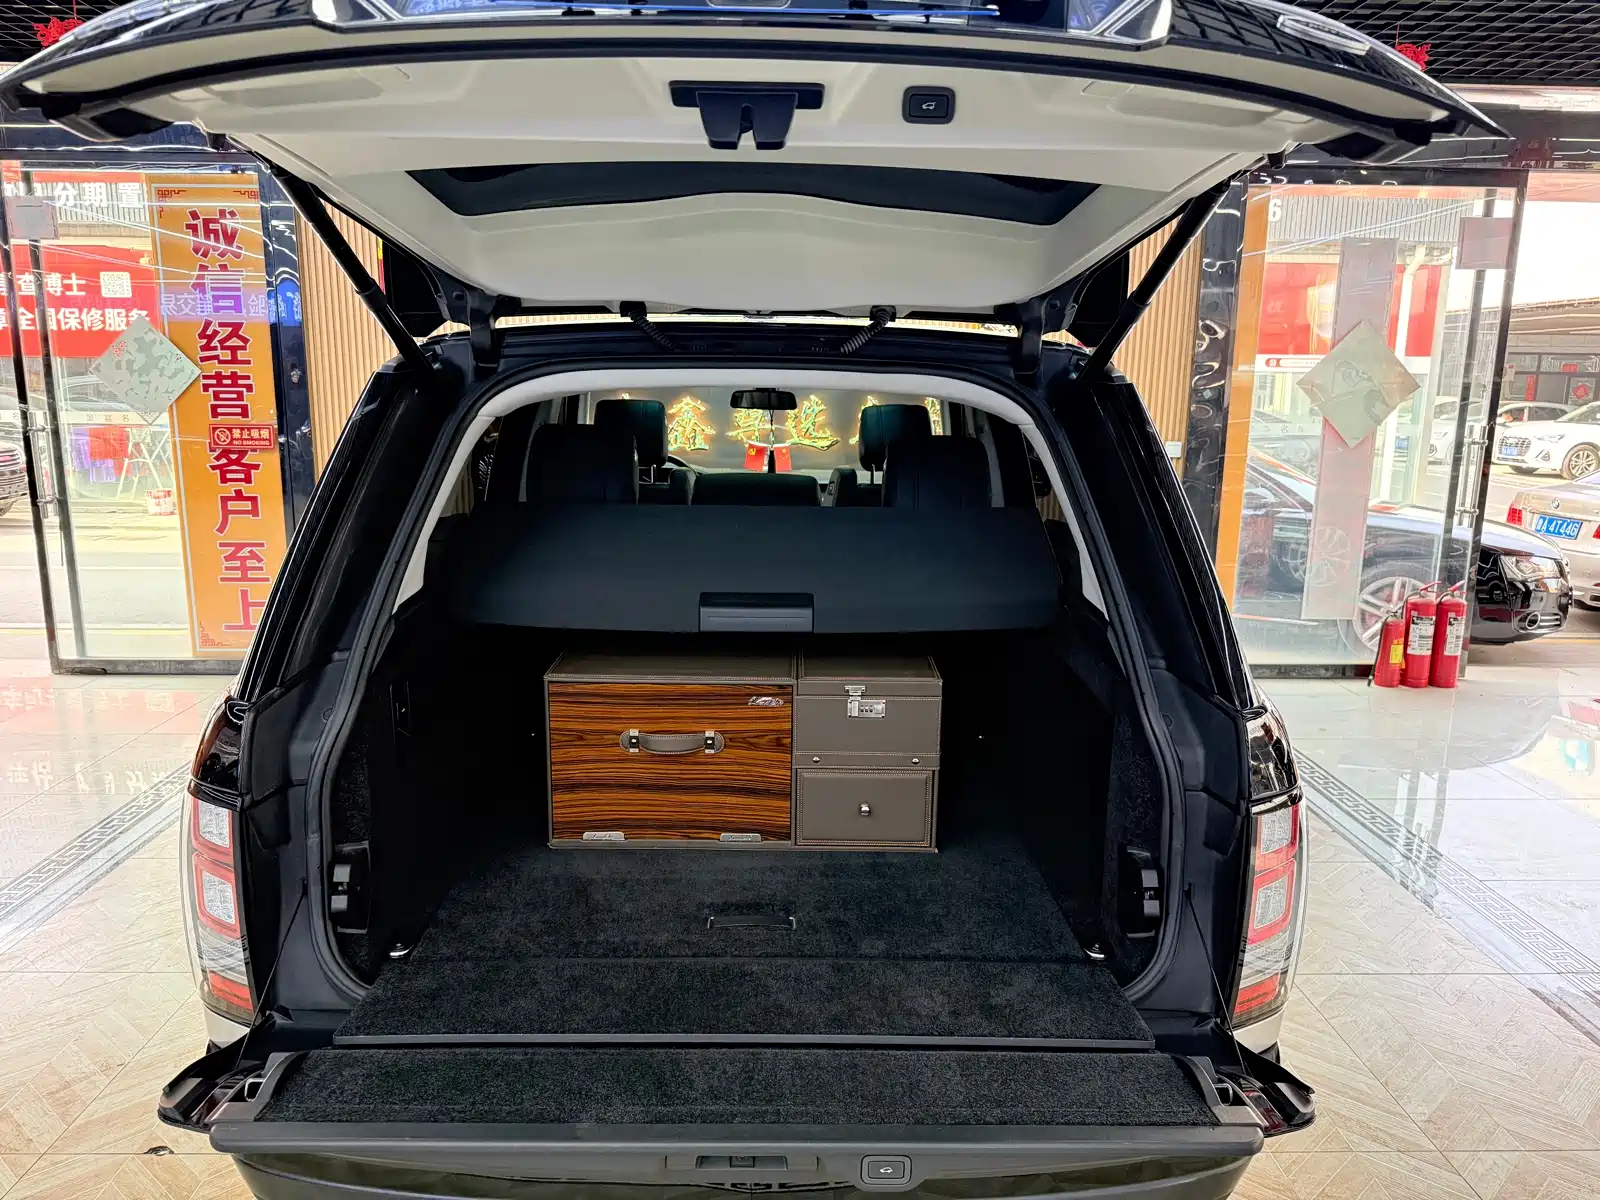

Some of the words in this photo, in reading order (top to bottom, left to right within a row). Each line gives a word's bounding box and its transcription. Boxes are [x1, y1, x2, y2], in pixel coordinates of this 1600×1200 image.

[184, 207, 273, 633] 诚信经营客户至上
[232, 428, 270, 439] 禁止吸烟
